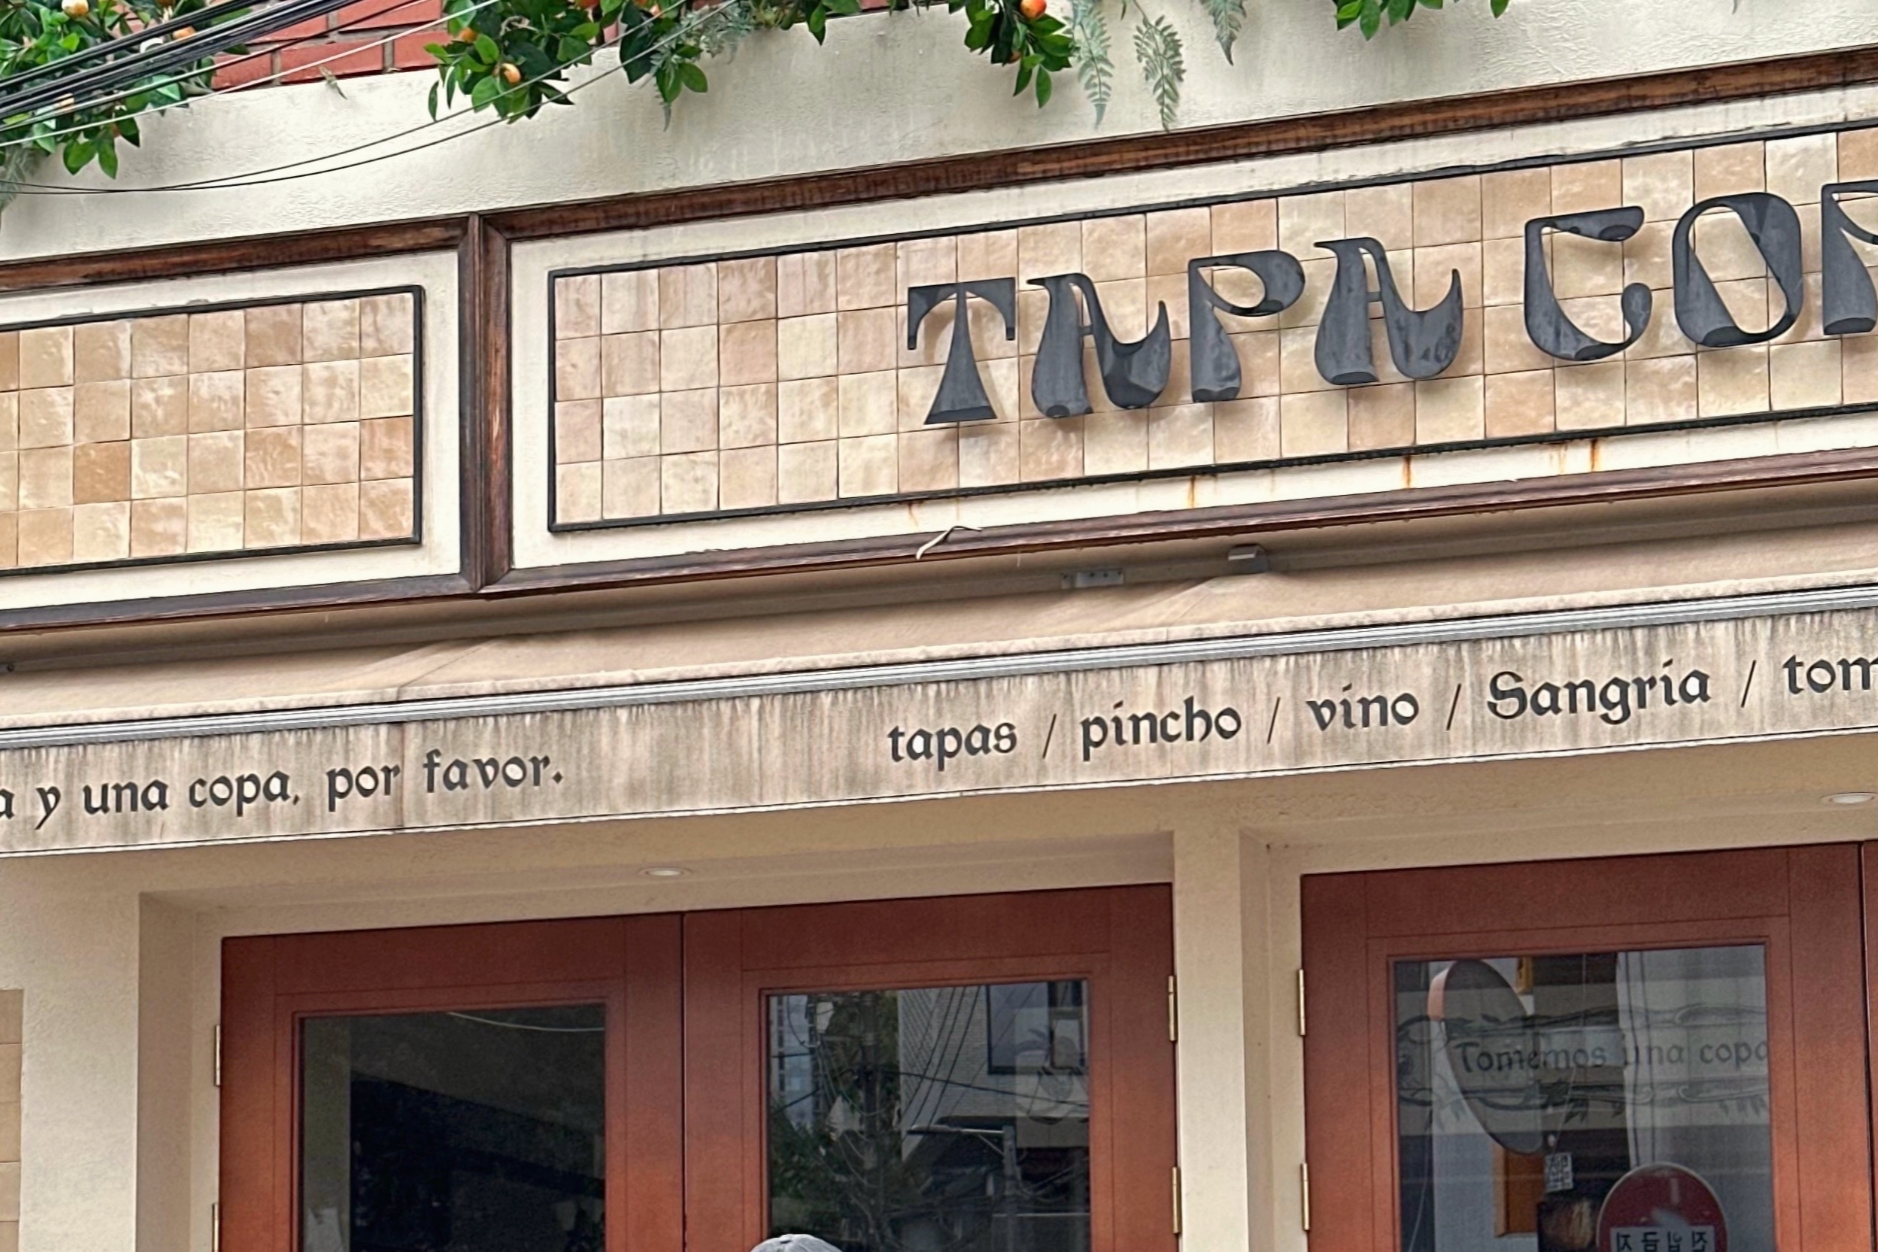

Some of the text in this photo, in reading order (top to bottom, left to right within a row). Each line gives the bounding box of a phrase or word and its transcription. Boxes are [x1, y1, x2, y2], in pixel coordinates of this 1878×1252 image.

[905, 236, 1464, 426] TAPA
[886, 721, 1018, 772] tapas
[36, 785, 61, 831] y
[82, 778, 170, 816] una
[188, 770, 300, 818] copa,
[326, 763, 401, 813] por
[422, 748, 564, 794] favor.
[1454, 1041, 1608, 1074] Tomemos
